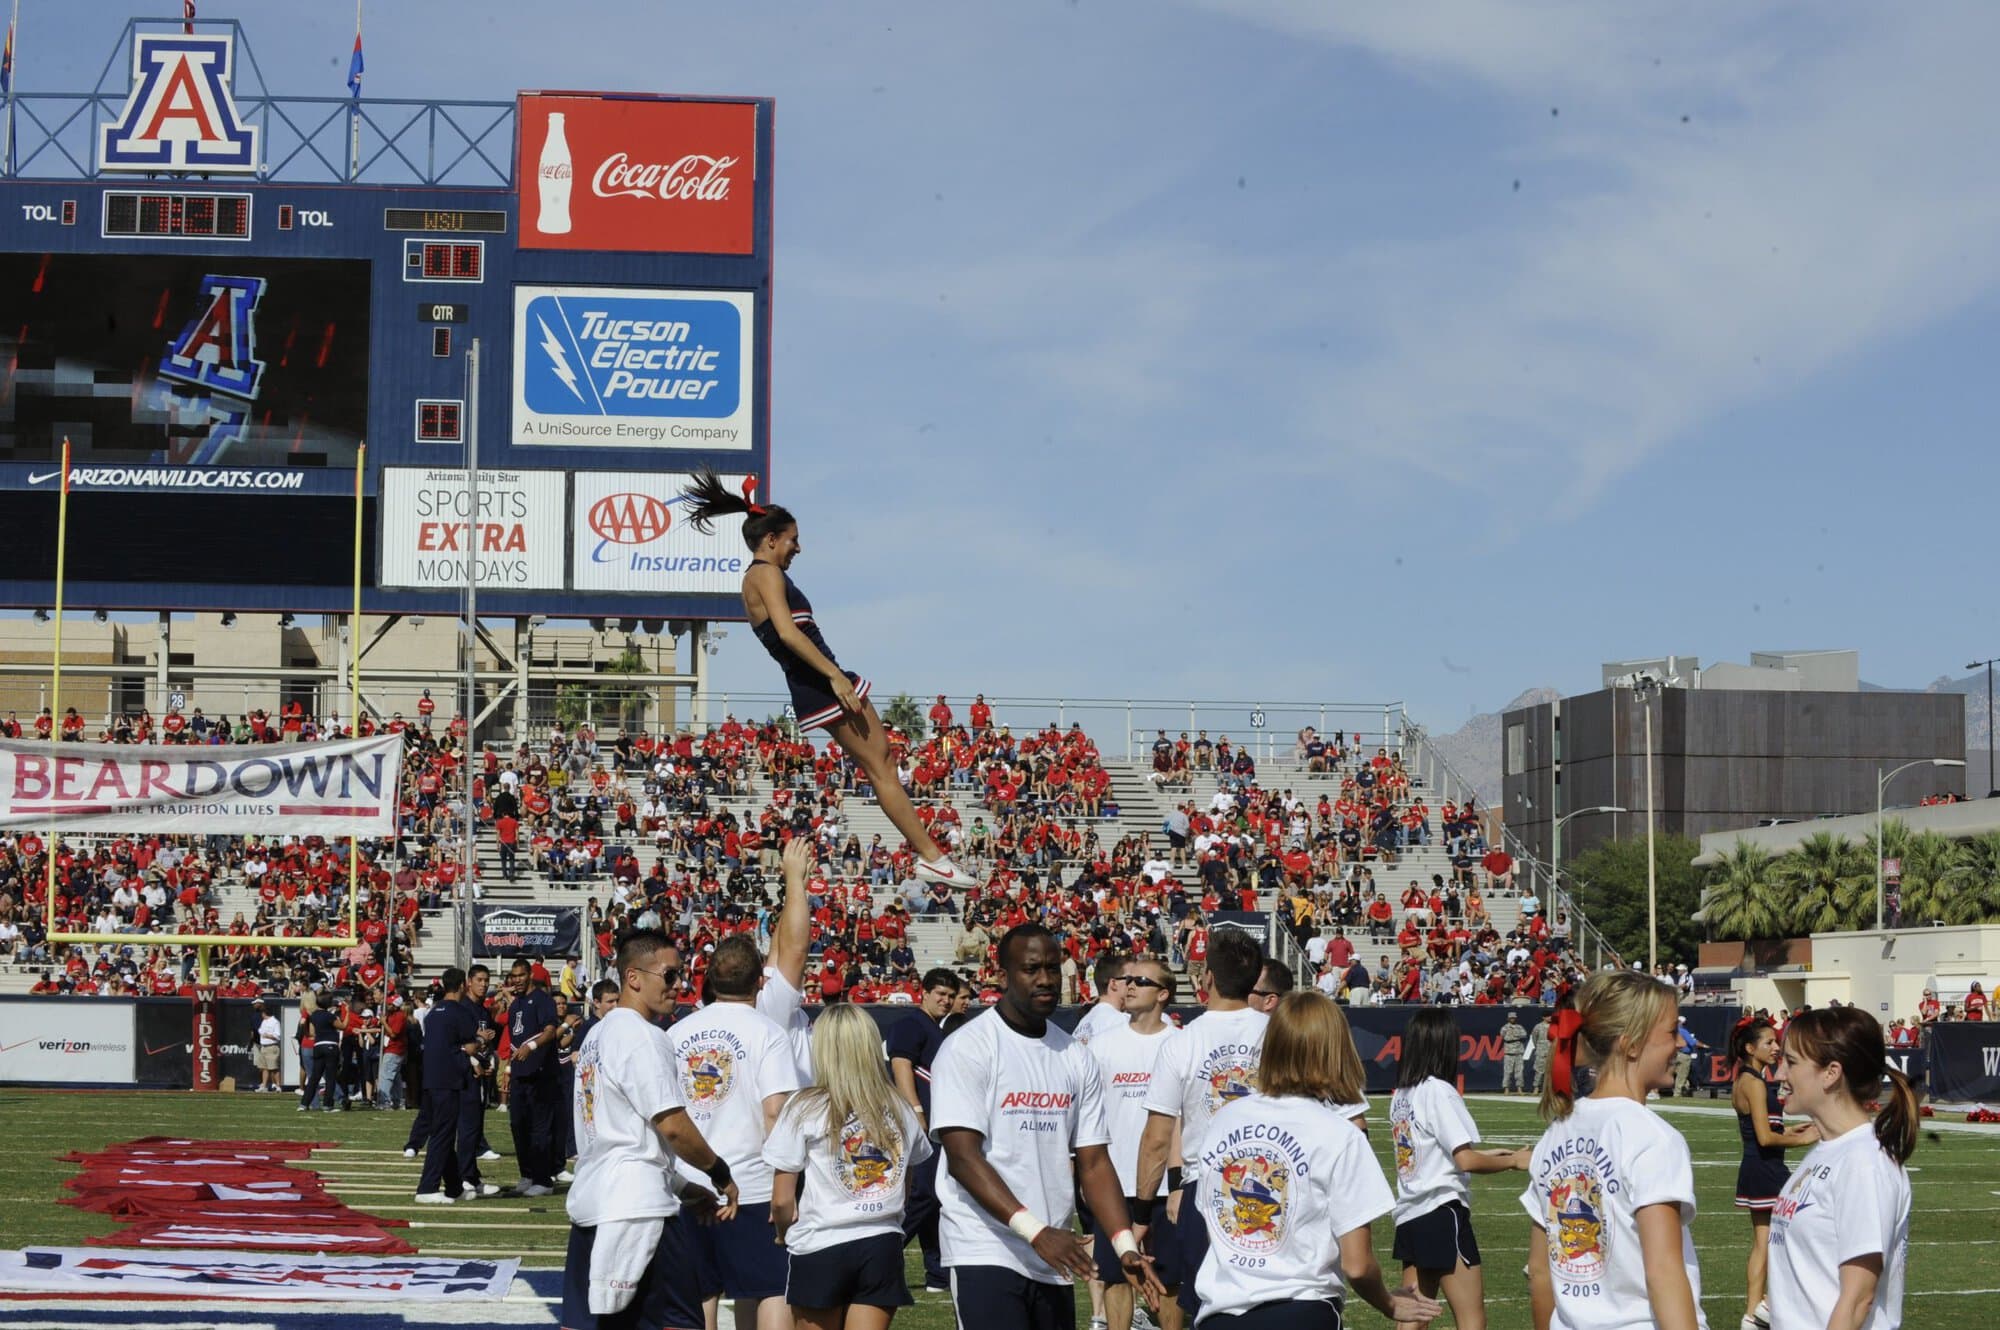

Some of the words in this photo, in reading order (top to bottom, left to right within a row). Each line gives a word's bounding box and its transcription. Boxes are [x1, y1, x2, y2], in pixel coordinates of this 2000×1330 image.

[592, 152, 739, 201] Coca-Cola
[22, 205, 57, 221] TOL
[298, 210, 334, 227] TOL
[424, 211, 463, 231] WSU
[432, 305, 454, 321] QTR
[580, 312, 690, 342] Tucson
[590, 343, 719, 371] Electric
[603, 371, 719, 400] Power
[523, 422, 533, 434] A
[538, 422, 612, 436] UniSource
[616, 423, 666, 440] Energy
[671, 425, 739, 442] Company
[68, 468, 305, 489] ARIZONAWILDCATS.COM
[425, 471, 466, 481] Arizona
[497, 472, 520, 482] Star
[417, 489, 527, 518] SPORTS
[599, 494, 662, 543] AAA
[417, 522, 527, 552] EXTRA
[417, 559, 528, 583] MONDAYS
[630, 552, 742, 573] Insurance
[171, 694, 184, 708] 28
[1251, 712, 1264, 727] 30
[117, 804, 144, 815] THE
[150, 803, 231, 815] TRADITION
[235, 804, 275, 815] LIVES
[486, 918, 526, 926] AMERICAN
[527, 918, 555, 926] FAMILY
[196, 990, 215, 1083] WILDCATS
[674, 1029, 746, 1061] HOMECOMING
[1196, 1044, 1261, 1081] HOMECOM
[1001, 1092, 1071, 1109] ARIZONA
[1202, 1124, 1309, 1177] HOMECOMING
[854, 1202, 883, 1212] 2009
[1229, 1254, 1266, 1268] 2009
[1561, 1283, 1601, 1298] 2009
